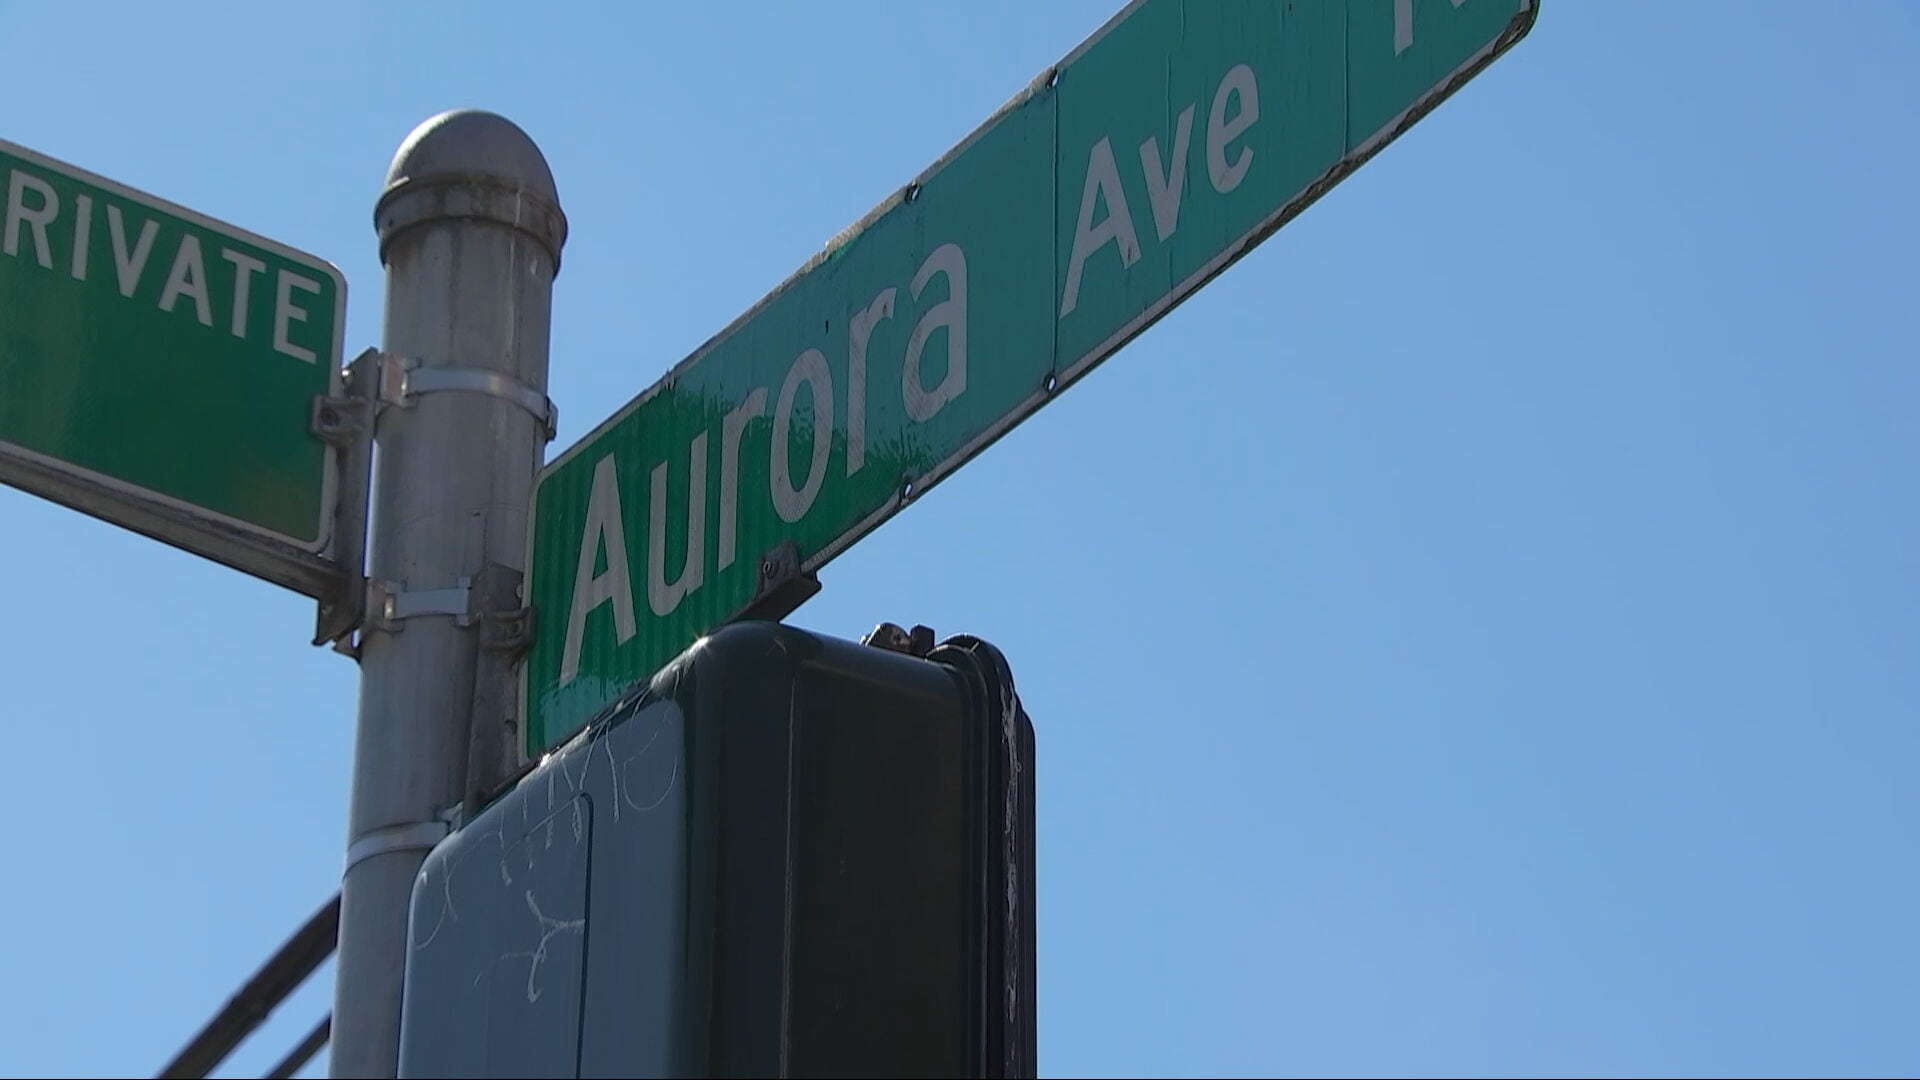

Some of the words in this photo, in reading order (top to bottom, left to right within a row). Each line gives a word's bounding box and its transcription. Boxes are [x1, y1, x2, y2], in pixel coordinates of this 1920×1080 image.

[3, 169, 320, 364] RIVATE
[560, 243, 968, 687] Aurora
[1060, 64, 1259, 319] Ave
